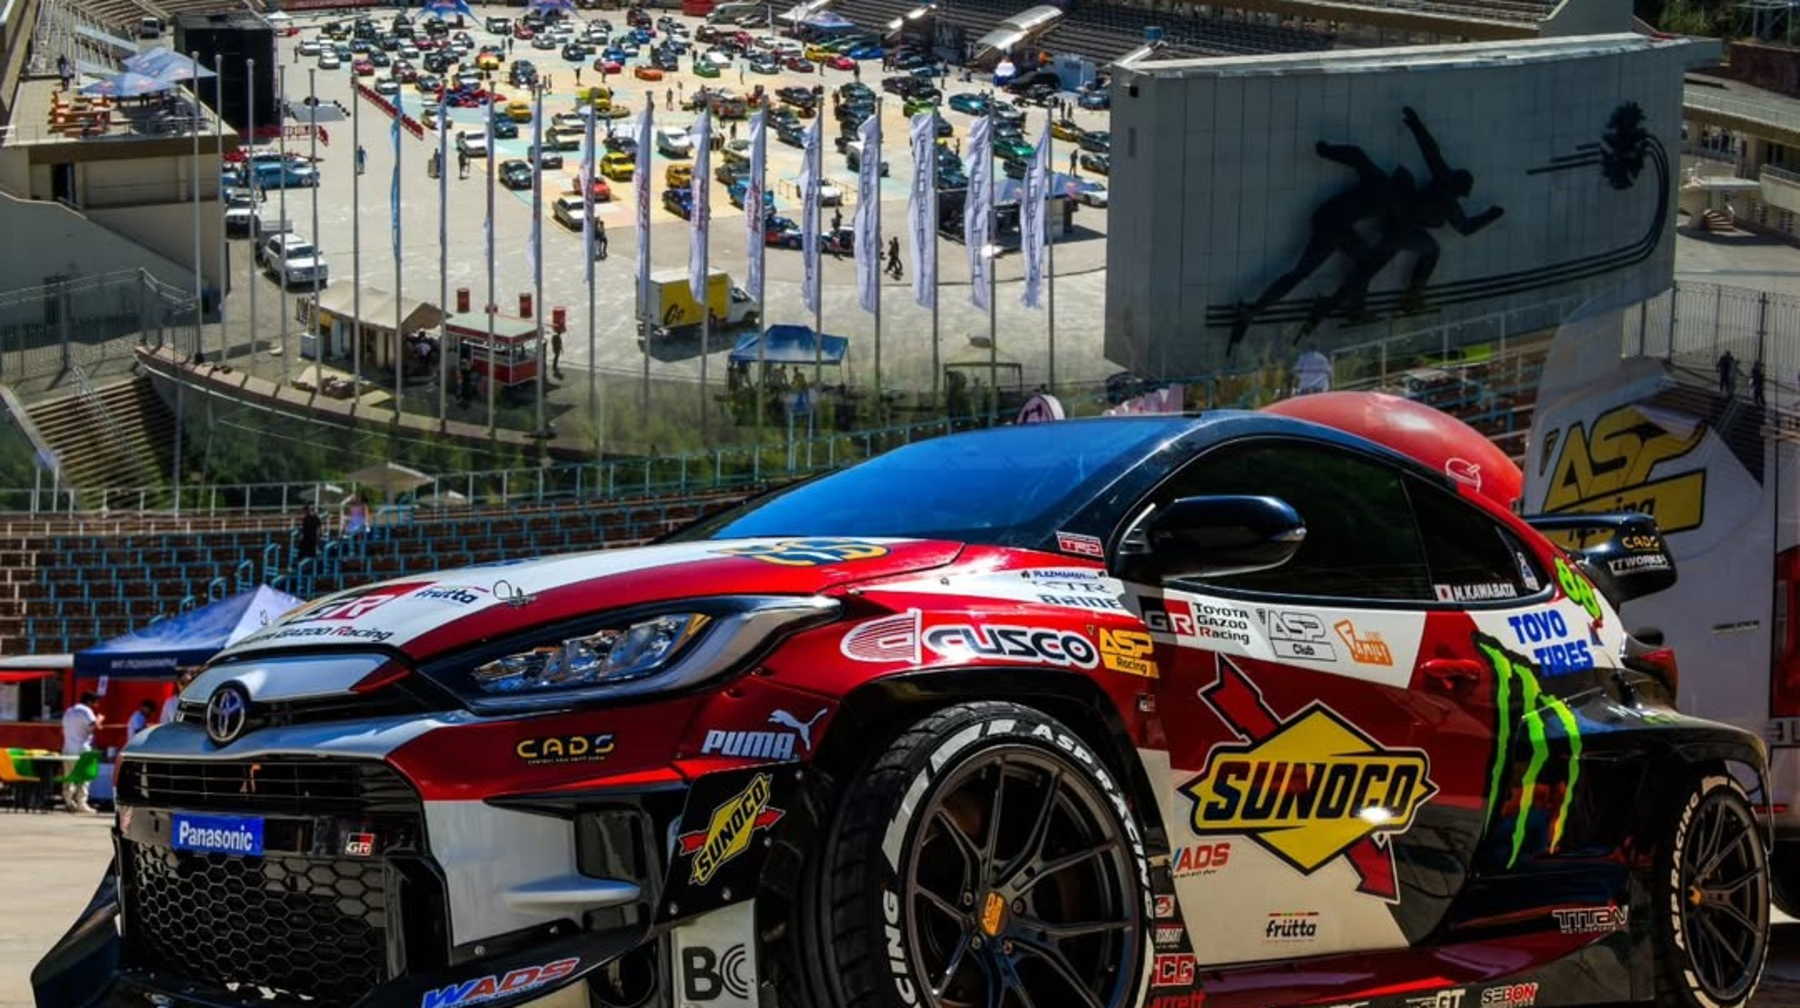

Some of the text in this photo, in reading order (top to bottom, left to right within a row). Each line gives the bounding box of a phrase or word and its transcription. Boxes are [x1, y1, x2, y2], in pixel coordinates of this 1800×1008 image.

[1192, 602, 1250, 619] TOYOTA
[1197, 615, 1249, 631] GAZOO
[330, 625, 394, 643] Racing
[1145, 611, 1196, 636] GR
[926, 627, 1097, 667] CUSCO
[1199, 627, 1251, 646] Racing
[1292, 643, 1315, 657] Club
[1534, 639, 1595, 679] TIRES
[1116, 656, 1148, 675] Racing
[516, 734, 615, 759] CADS
[701, 729, 797, 760] PUMA
[1202, 761, 1419, 822] SUNOCO
[698, 779, 767, 880] SUNOCO
[1031, 723, 1155, 920] ASP RACING
[178, 820, 254, 851] Panasonic
[1172, 843, 1231, 872] ADS
[1265, 919, 1317, 938] frütta
[421, 956, 581, 1008] WADS
[1481, 983, 1539, 1003] SEBON
